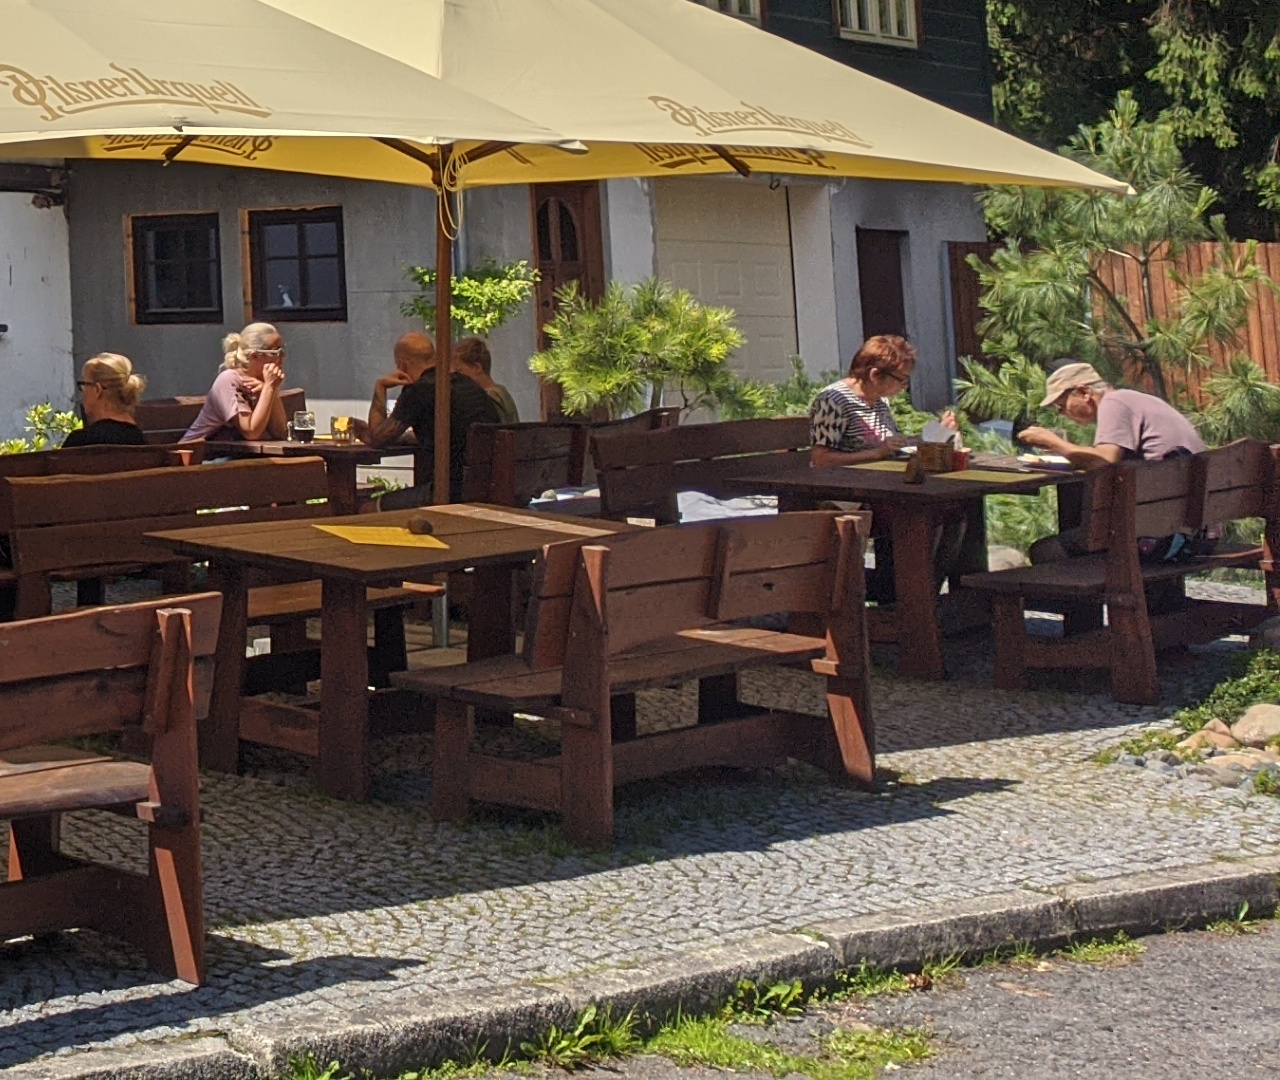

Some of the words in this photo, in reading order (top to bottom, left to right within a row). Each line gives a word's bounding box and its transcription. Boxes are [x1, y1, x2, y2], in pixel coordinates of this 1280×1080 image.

[109, 62, 262, 115] Urquell
[648, 95, 766, 137] Pilsner
[740, 100, 866, 142] Urquell
